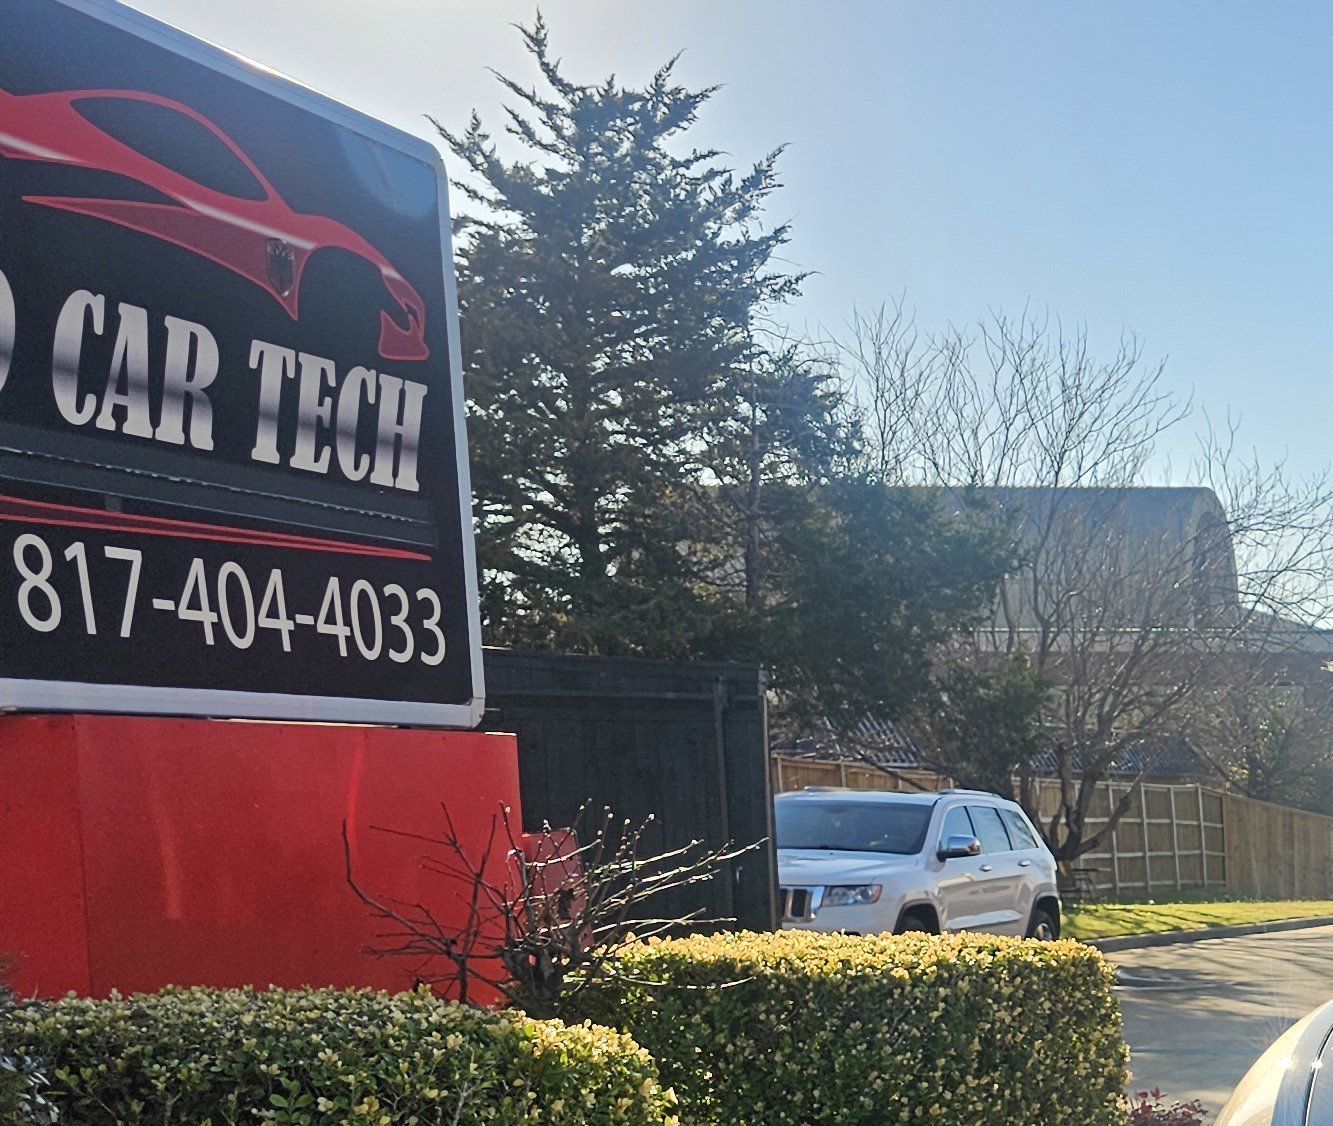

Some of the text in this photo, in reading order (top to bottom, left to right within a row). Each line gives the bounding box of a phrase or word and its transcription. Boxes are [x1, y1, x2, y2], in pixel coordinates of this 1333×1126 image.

[52, 289, 219, 451] CAR
[249, 339, 428, 493] TECH
[12, 533, 446, 666] 817-404-4033
